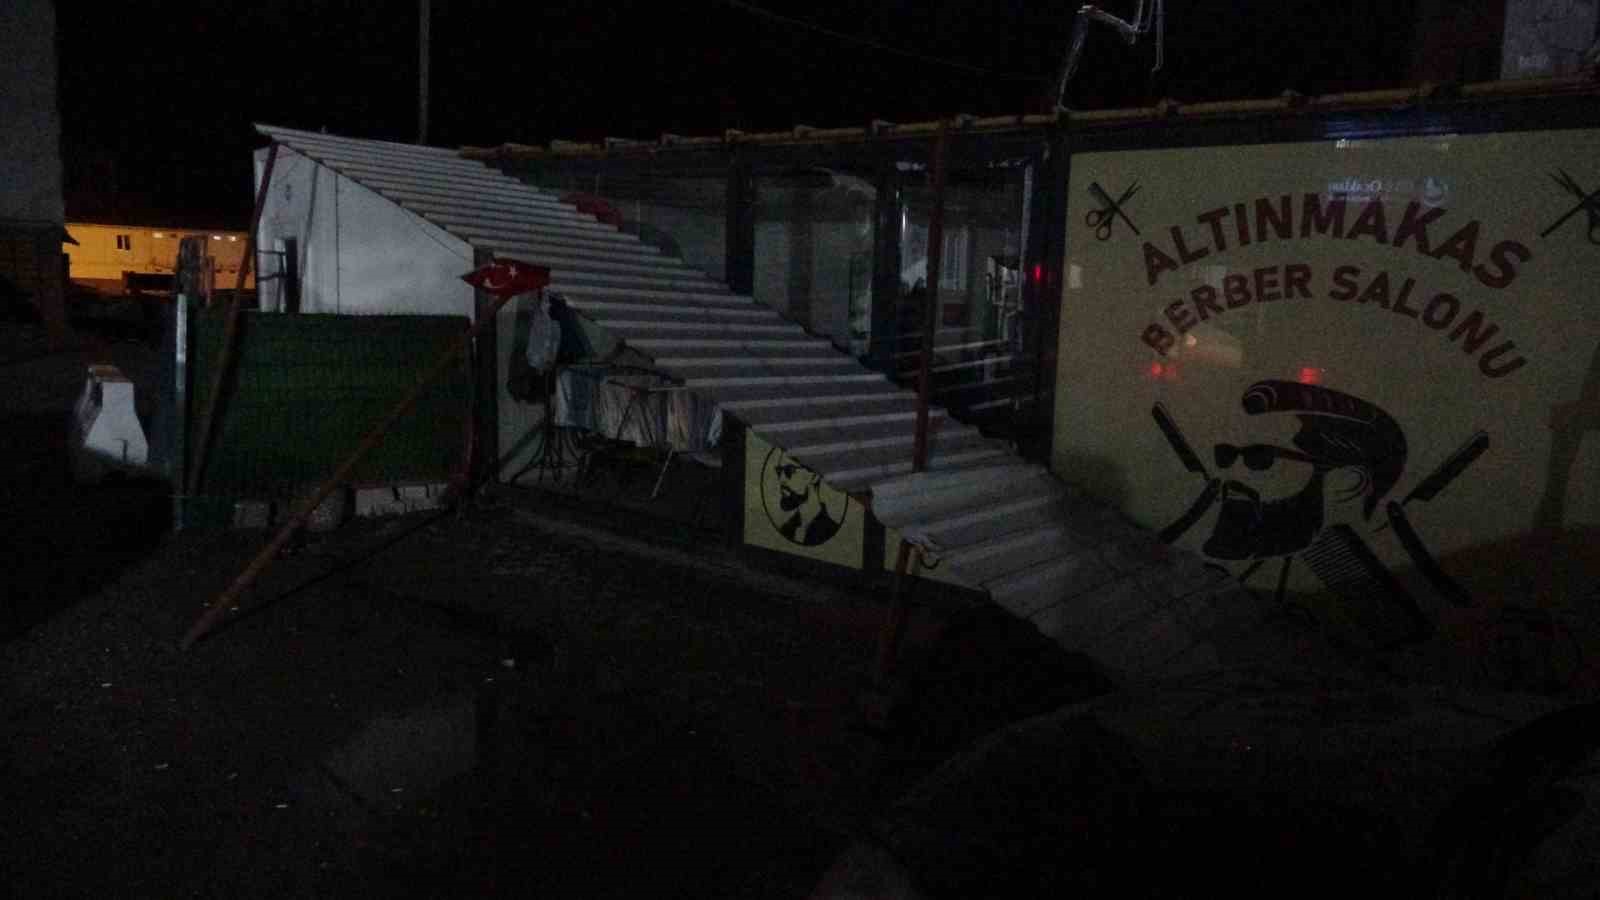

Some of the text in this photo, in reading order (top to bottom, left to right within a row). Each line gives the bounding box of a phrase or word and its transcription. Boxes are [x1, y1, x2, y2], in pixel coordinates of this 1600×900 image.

[1143, 193, 1530, 288] ALTINMAKAS
[1141, 264, 1526, 378] BERBER SALONU
